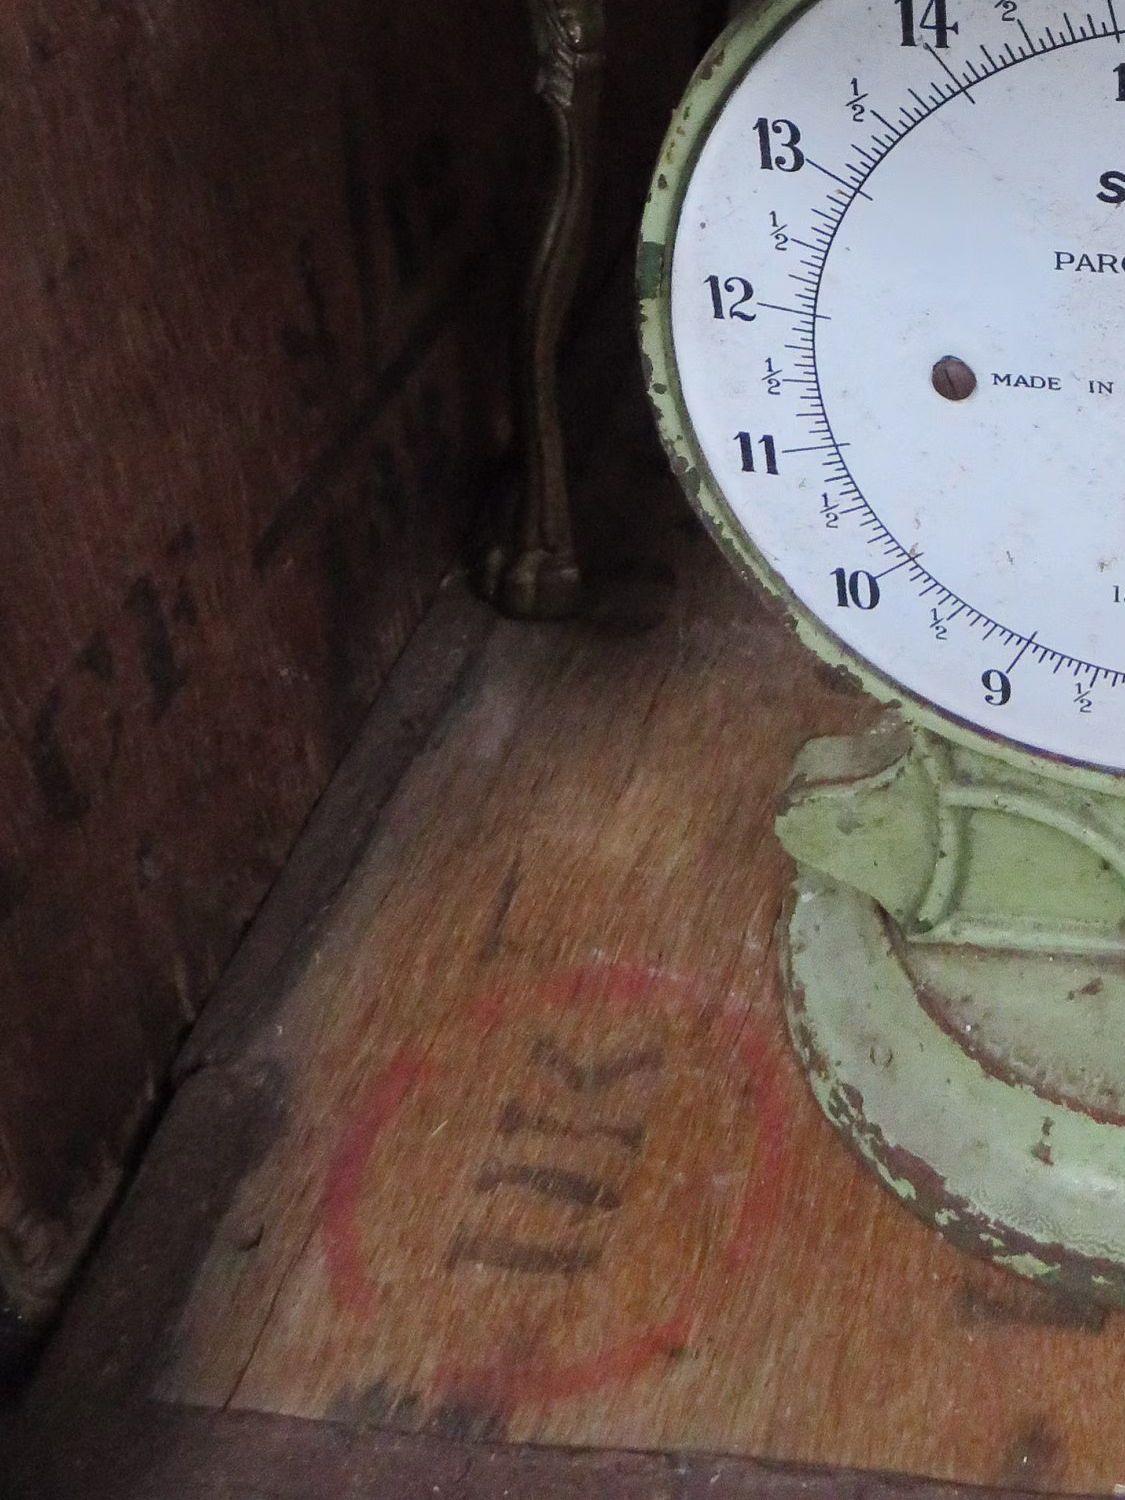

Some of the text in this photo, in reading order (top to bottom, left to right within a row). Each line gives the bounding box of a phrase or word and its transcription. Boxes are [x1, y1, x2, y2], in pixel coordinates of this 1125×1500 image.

[752, 117, 806, 173] 13
[702, 275, 757, 322] 12
[991, 372, 1063, 391] MADE
[1088, 379, 1115, 396] IN
[732, 431, 780, 476] 11
[830, 568, 881, 610] 10
[981, 669, 1012, 706] 9
